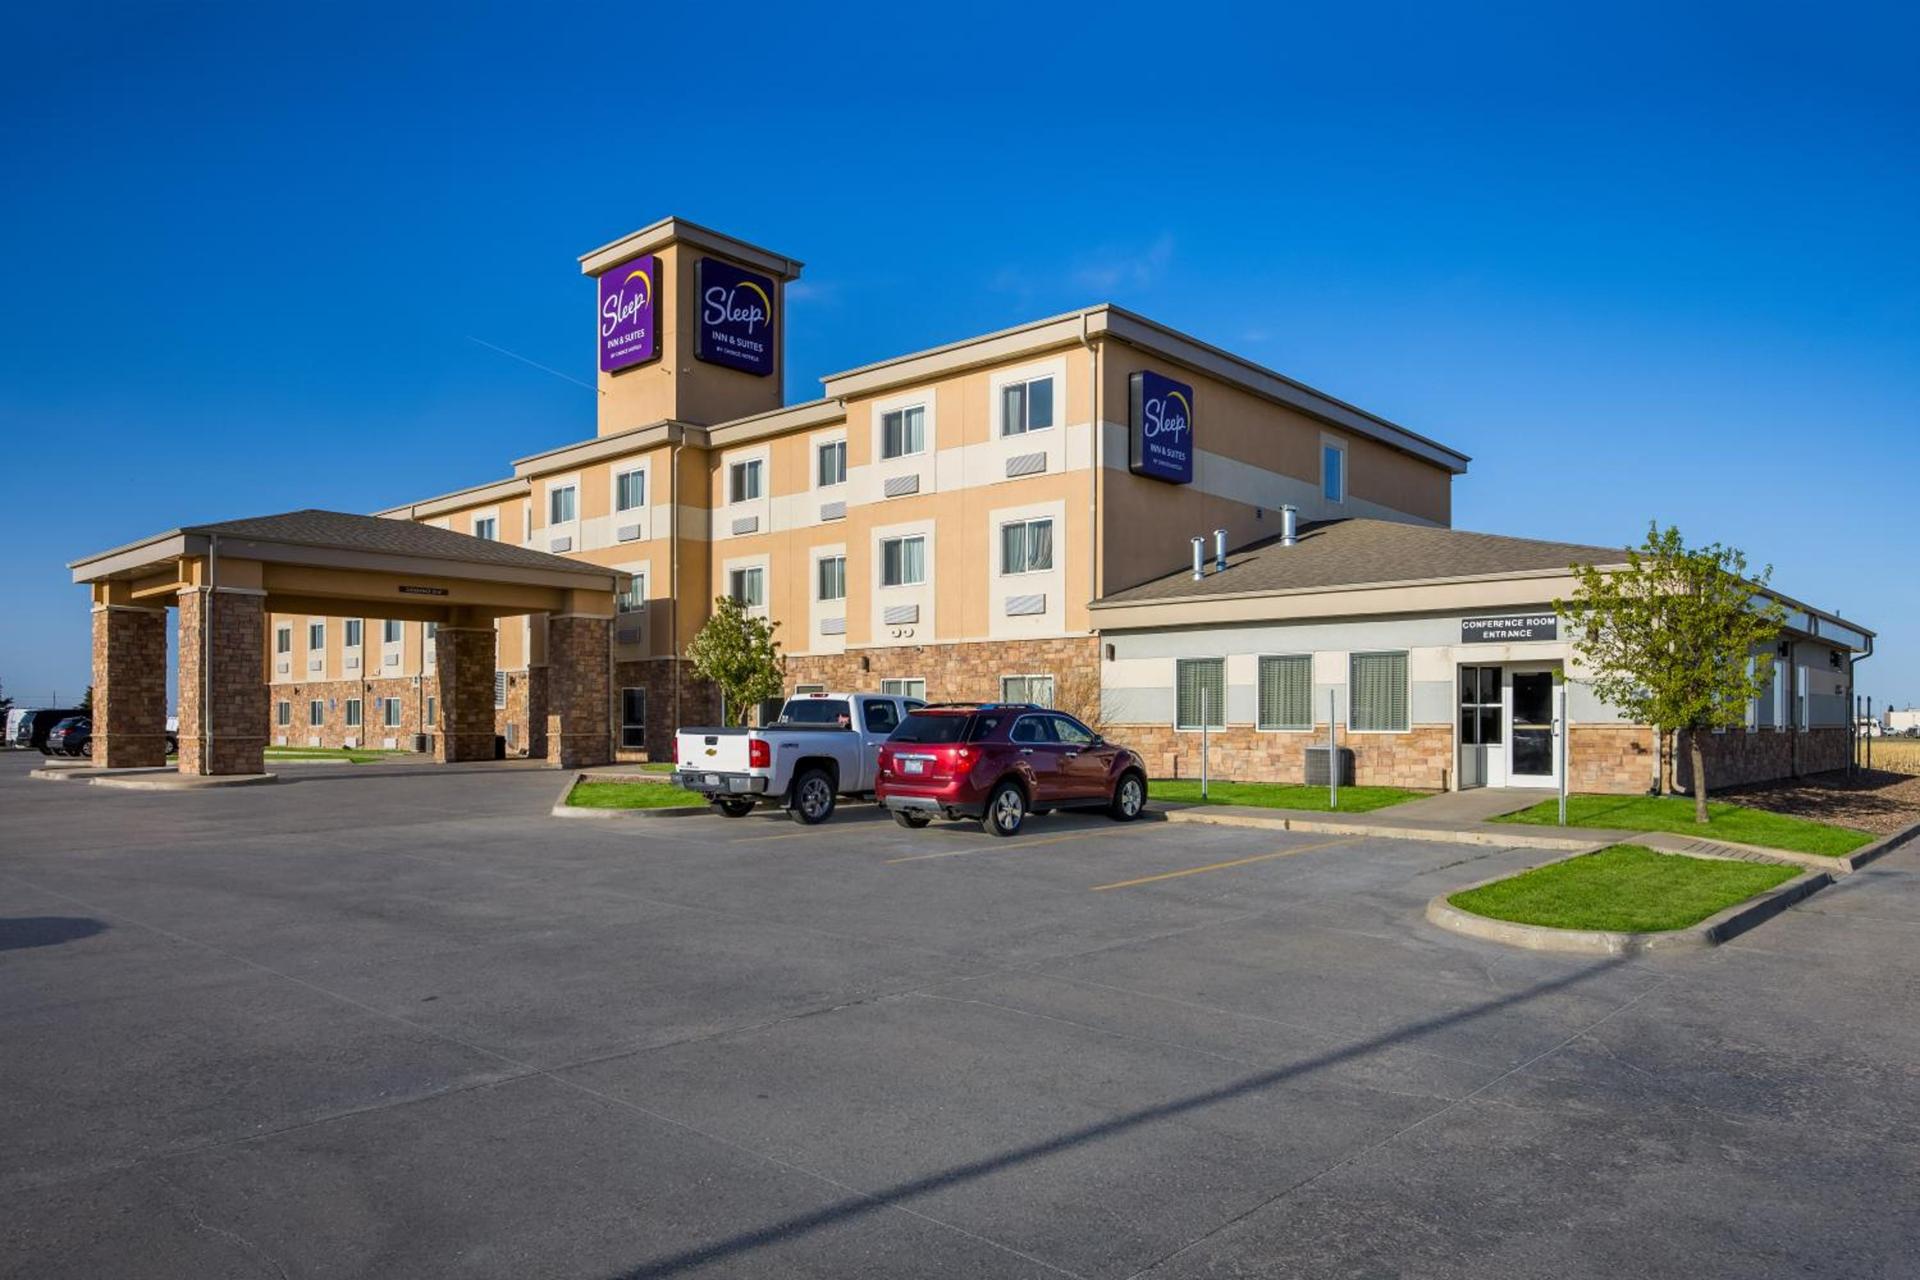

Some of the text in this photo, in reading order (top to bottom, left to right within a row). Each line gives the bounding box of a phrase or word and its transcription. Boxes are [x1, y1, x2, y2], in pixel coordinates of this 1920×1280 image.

[602, 289, 646, 337] Sleep
[704, 286, 764, 335] Sleep
[607, 338, 619, 349] INN
[624, 328, 646, 343] SUITES
[712, 330, 764, 353] INN & SUITES
[1144, 398, 1186, 444] Sleep
[1166, 448, 1186, 461] SUITES
[1462, 617, 1556, 630] CONFERENCE ROOM
[1483, 629, 1533, 639] ENTRANCE
